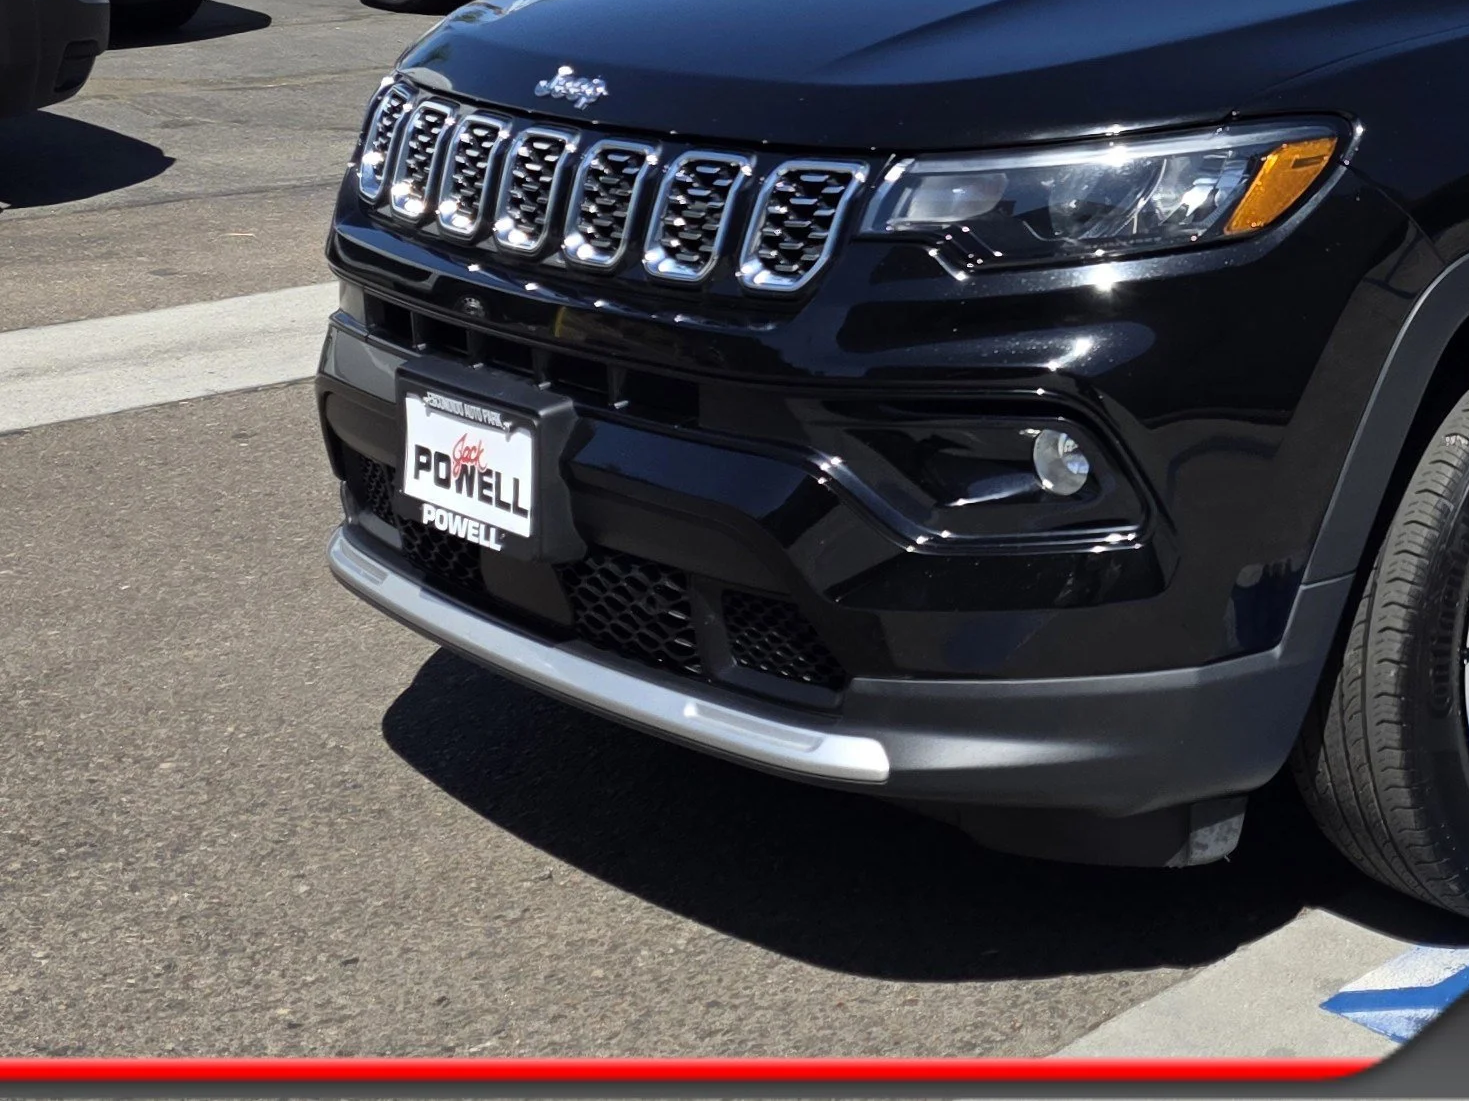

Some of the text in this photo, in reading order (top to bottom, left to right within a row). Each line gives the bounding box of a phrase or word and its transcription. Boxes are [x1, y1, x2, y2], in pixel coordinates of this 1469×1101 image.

[453, 433, 488, 479] Jack
[413, 444, 529, 520] POWELL
[422, 502, 503, 552] POWELL
